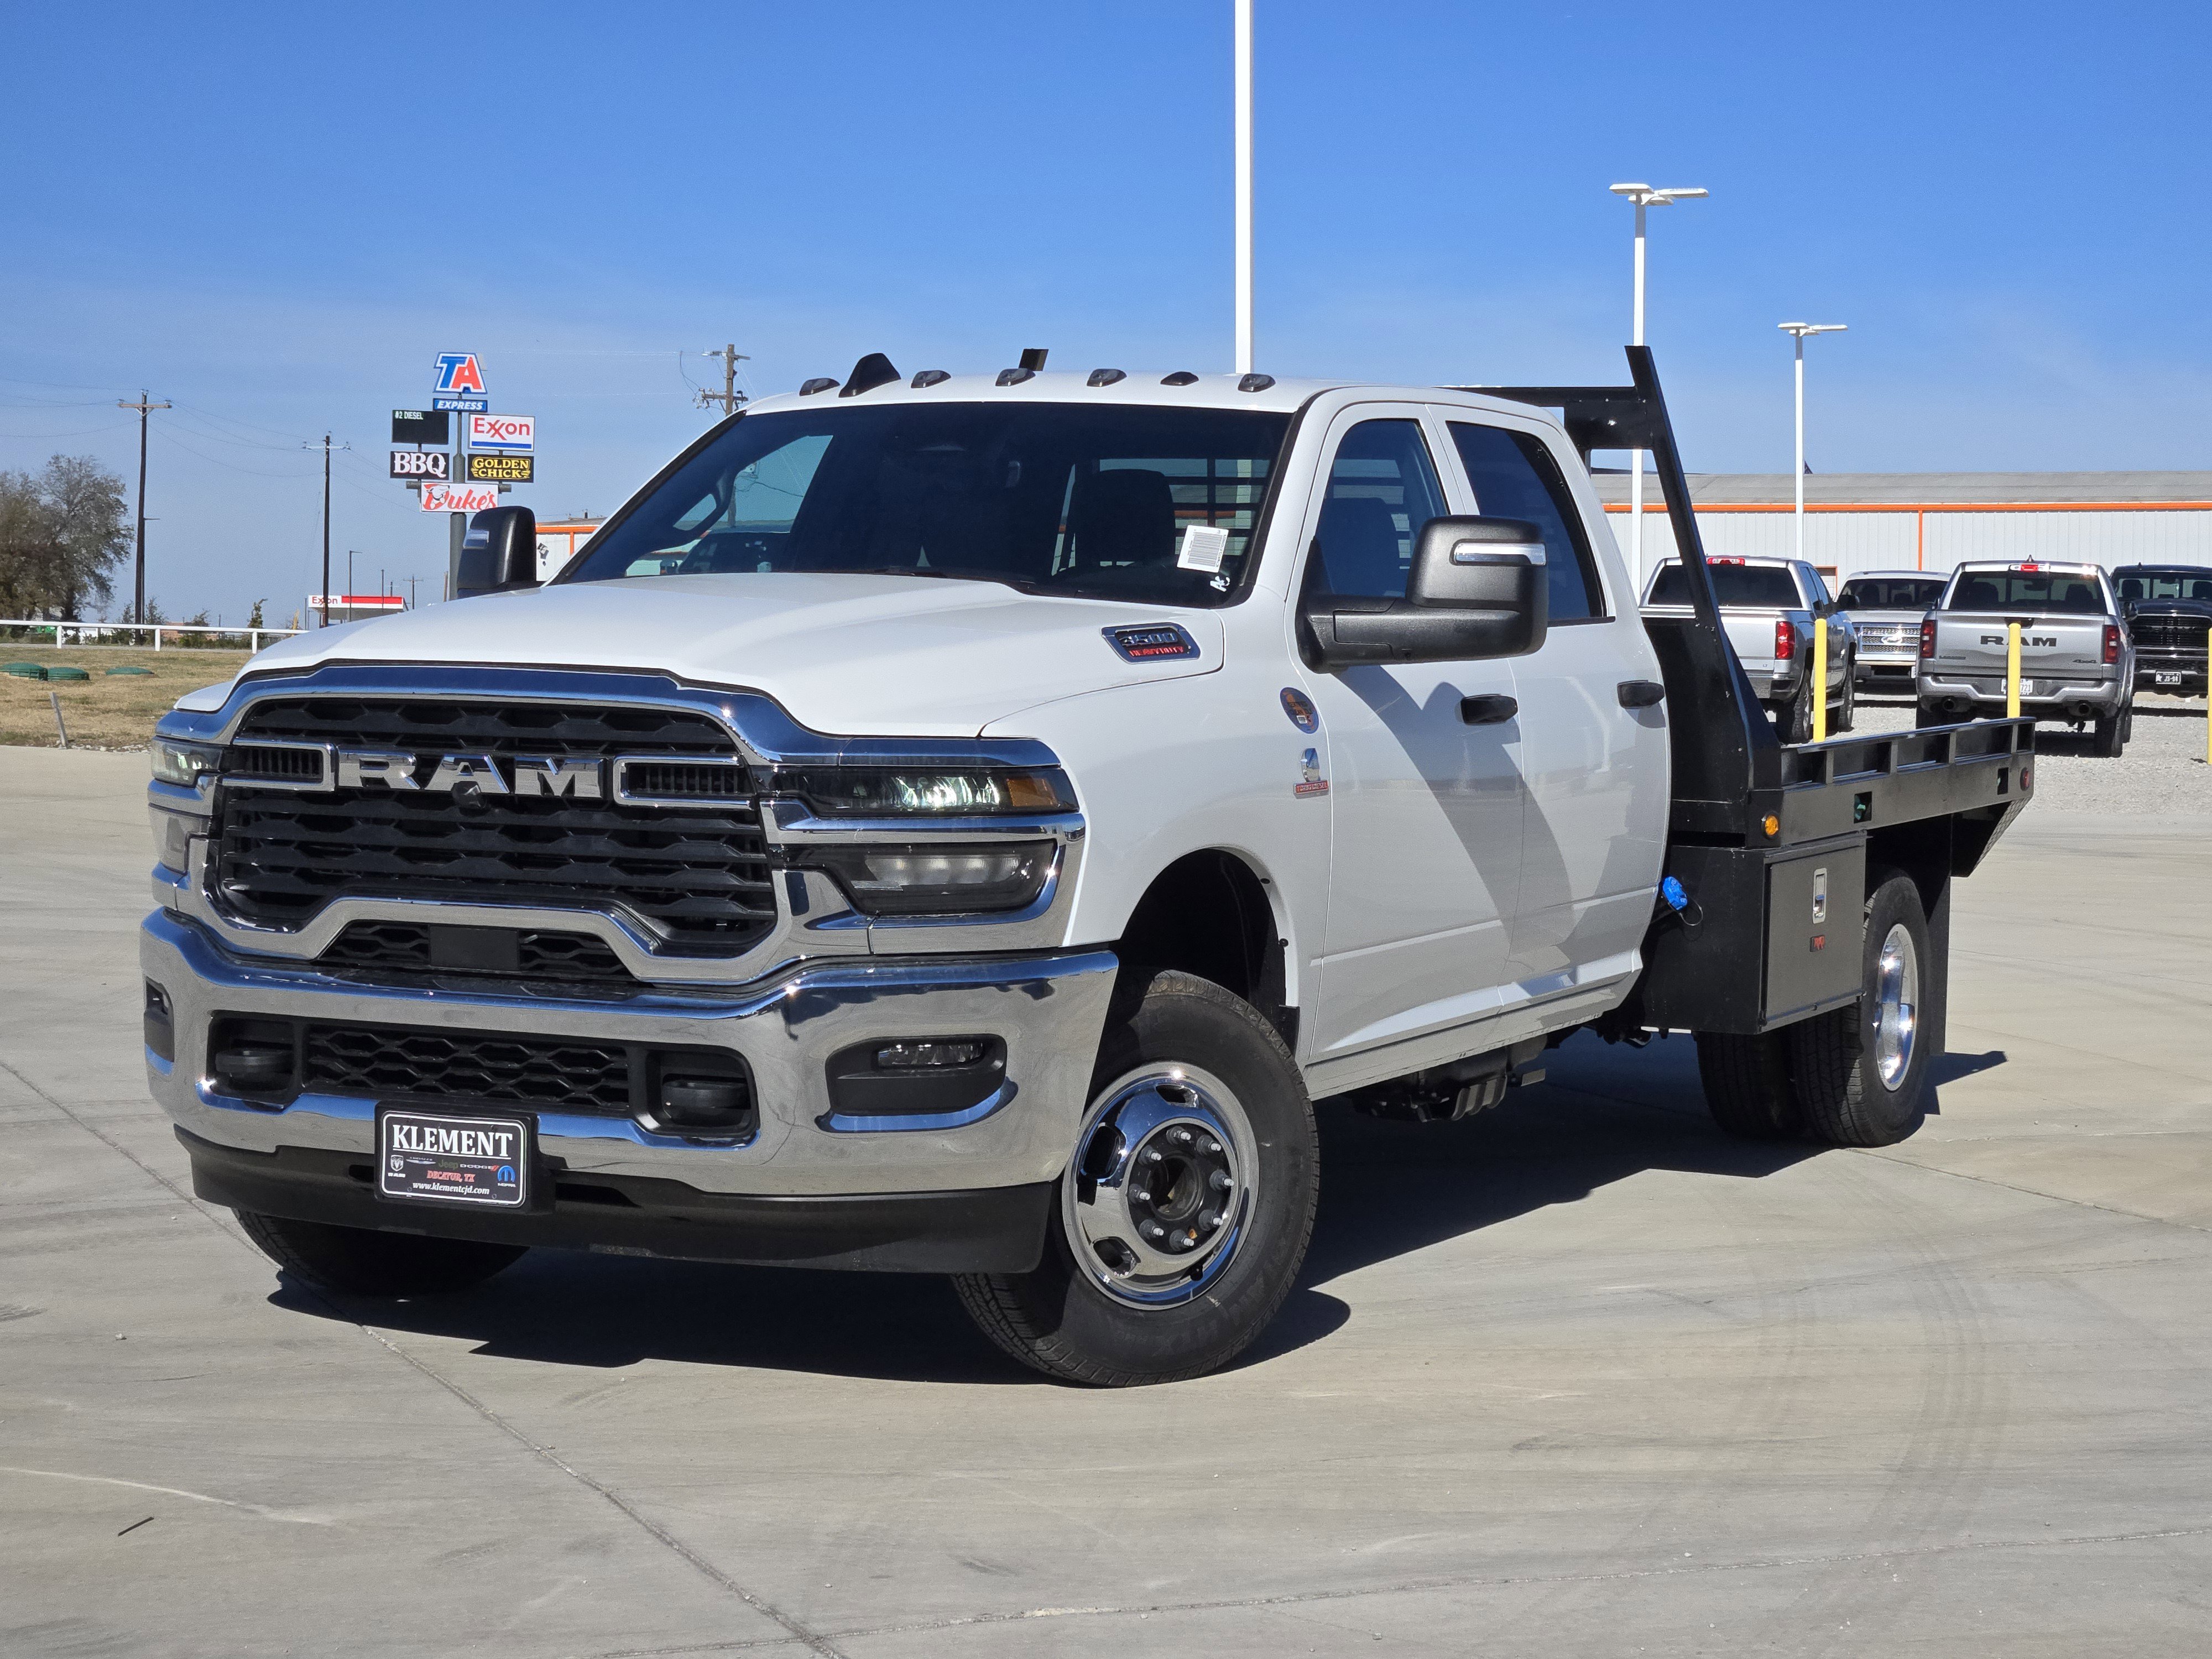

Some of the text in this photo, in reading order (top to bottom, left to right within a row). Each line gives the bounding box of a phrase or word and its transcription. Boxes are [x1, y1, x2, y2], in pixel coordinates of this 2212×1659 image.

[439, 355, 483, 390] TA
[437, 400, 483, 410] EXPRESS
[404, 411, 424, 420] DIESEL
[473, 417, 530, 441] Exxon
[393, 452, 447, 478] BBQ
[474, 458, 529, 469] GOLDEN
[478, 468, 522, 478] CHICK
[422, 483, 497, 510] Duke's
[338, 749, 607, 799] RAM
[392, 1124, 513, 1157] KLEMENT
[437, 1159, 459, 1170] Jeep
[463, 1173, 476, 1182] TX
[413, 1182, 490, 1195] www.klementcjd.com
